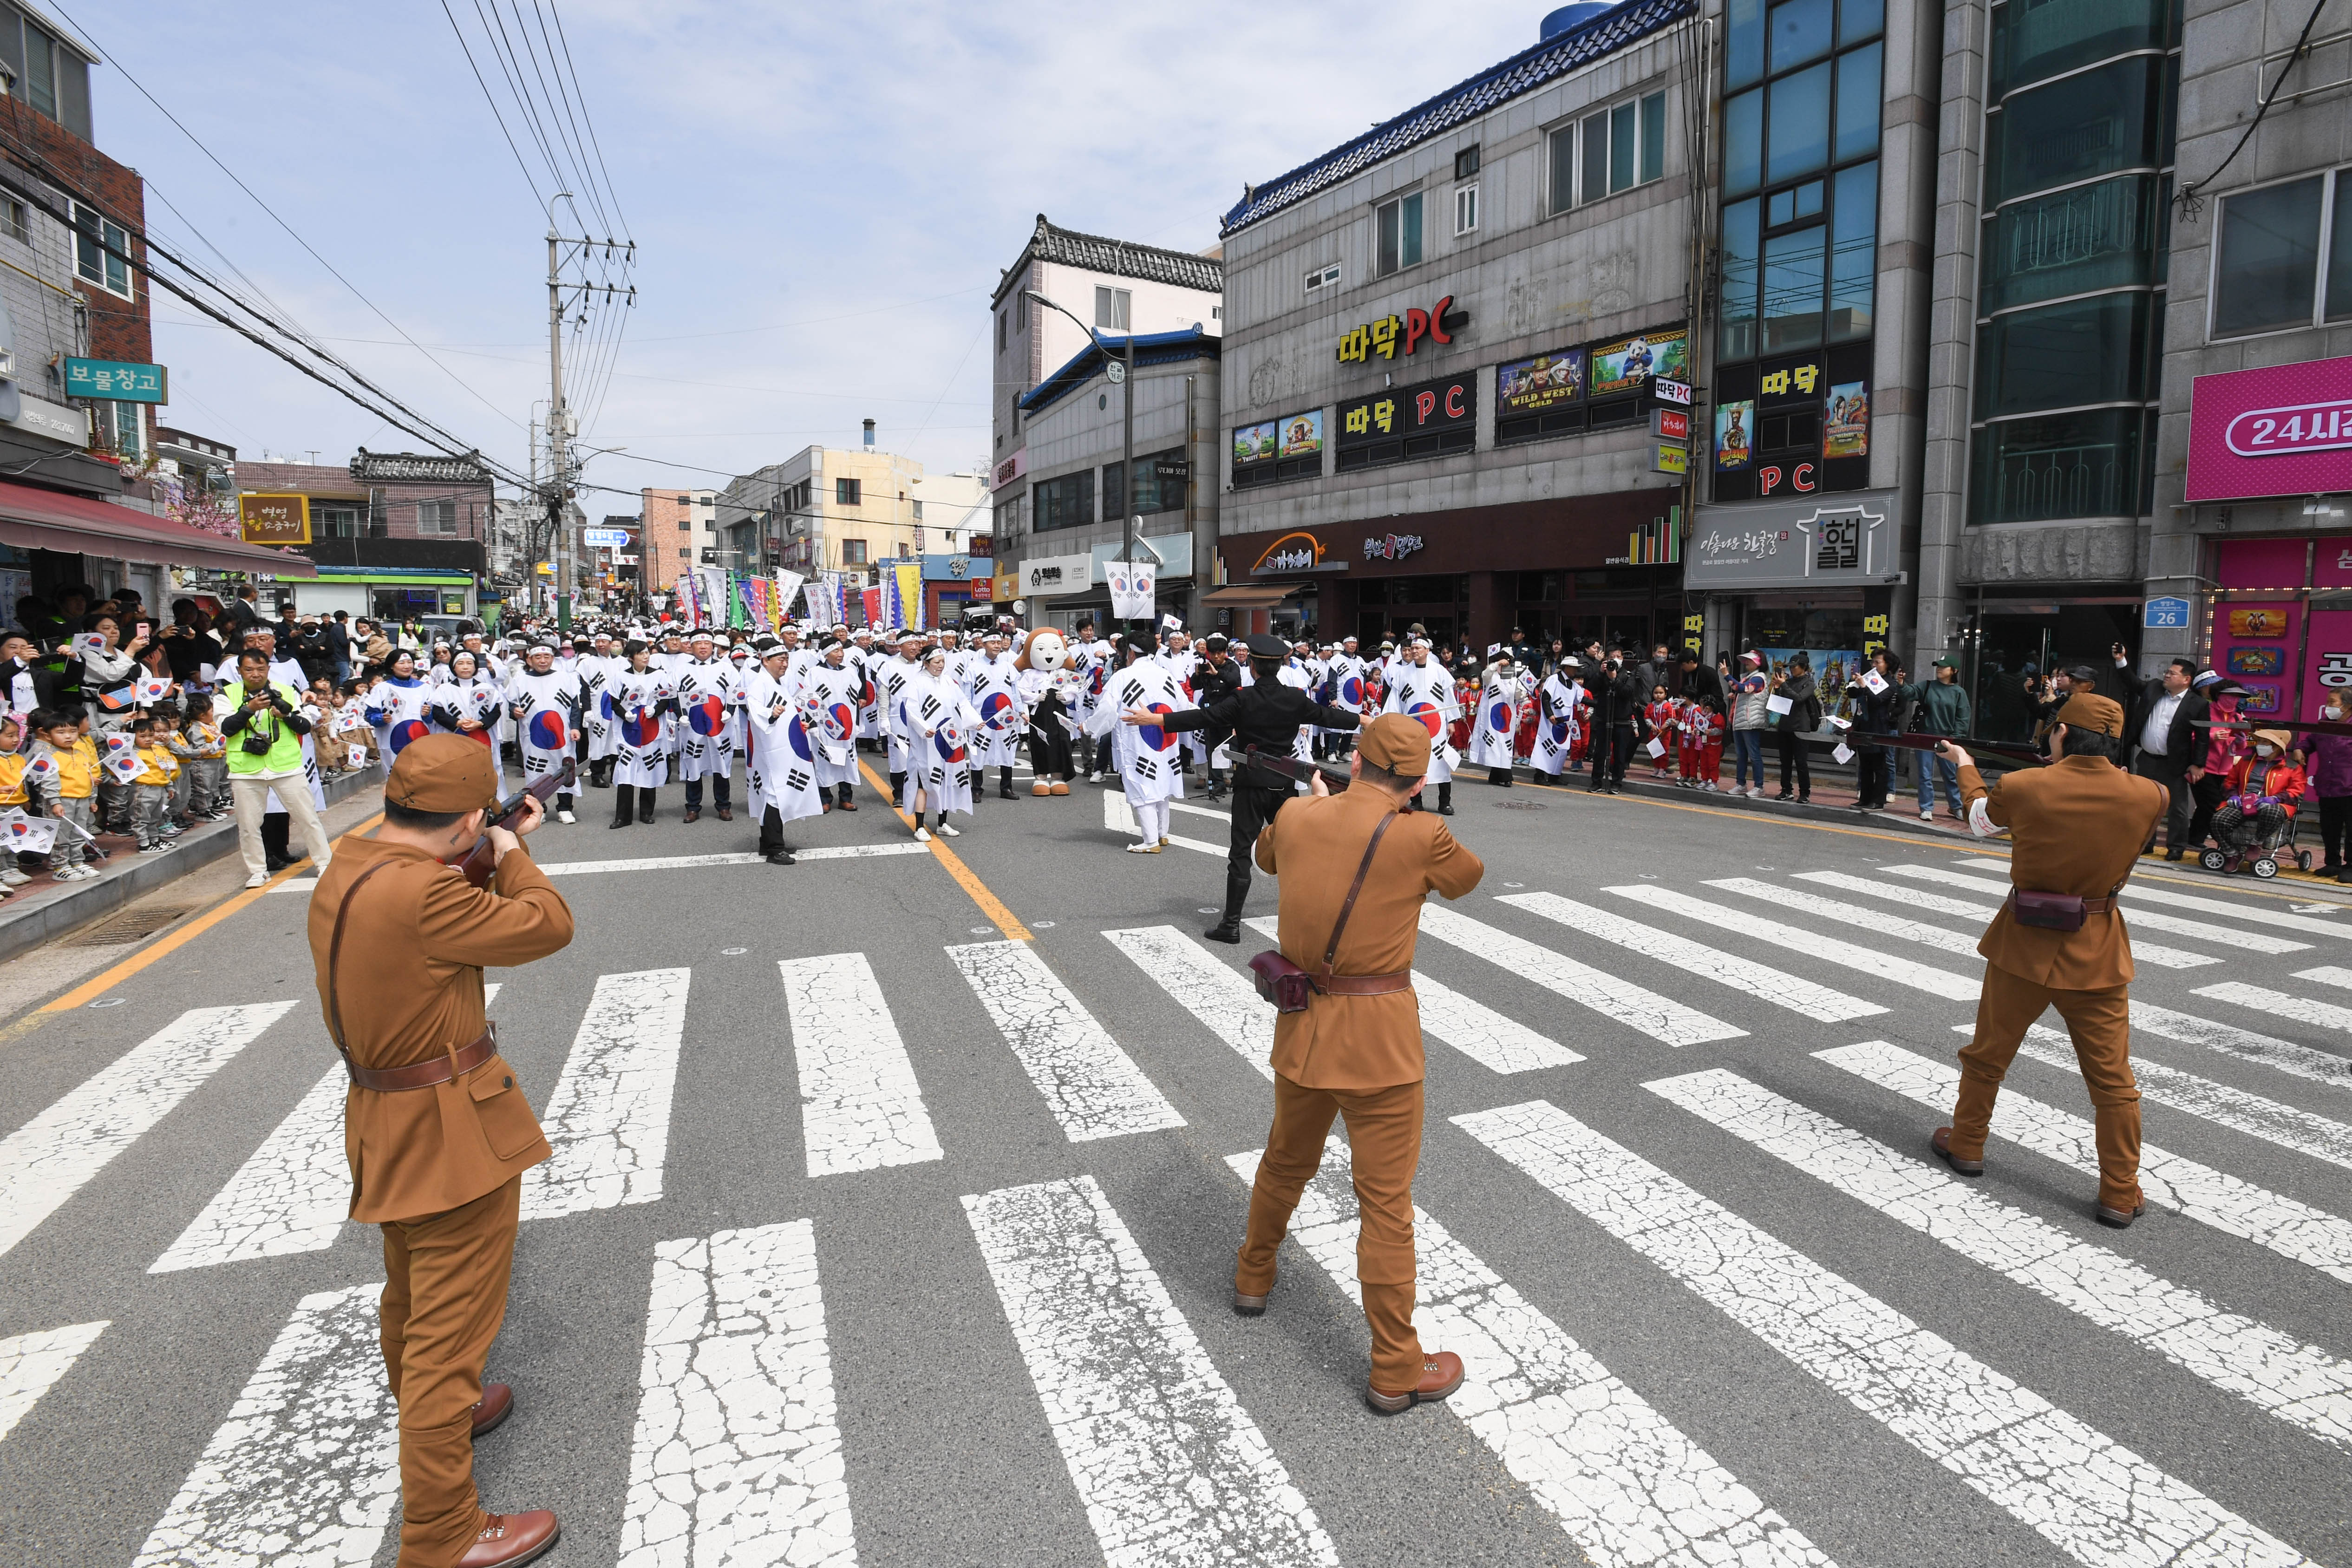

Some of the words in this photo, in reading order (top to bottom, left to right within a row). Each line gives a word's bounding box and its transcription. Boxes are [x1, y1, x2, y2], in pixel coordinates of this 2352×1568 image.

[70, 366, 158, 391] 보물창고
[1110, 364, 1122, 372] 한글
[1762, 364, 1819, 395] 따닥
[1511, 393, 1538, 406] WILD
[1542, 384, 1574, 399] WEST
[1346, 399, 1395, 434] 따닥
[1760, 463, 1815, 495] PC
[1364, 538, 1385, 560] 부산
[1396, 535, 1423, 560] 밀면
[1700, 530, 1740, 557] 아름다운
[1744, 530, 1778, 559] 한글길
[500, 577, 518, 586] CLOVER
[2157, 613, 2176, 624] 26
